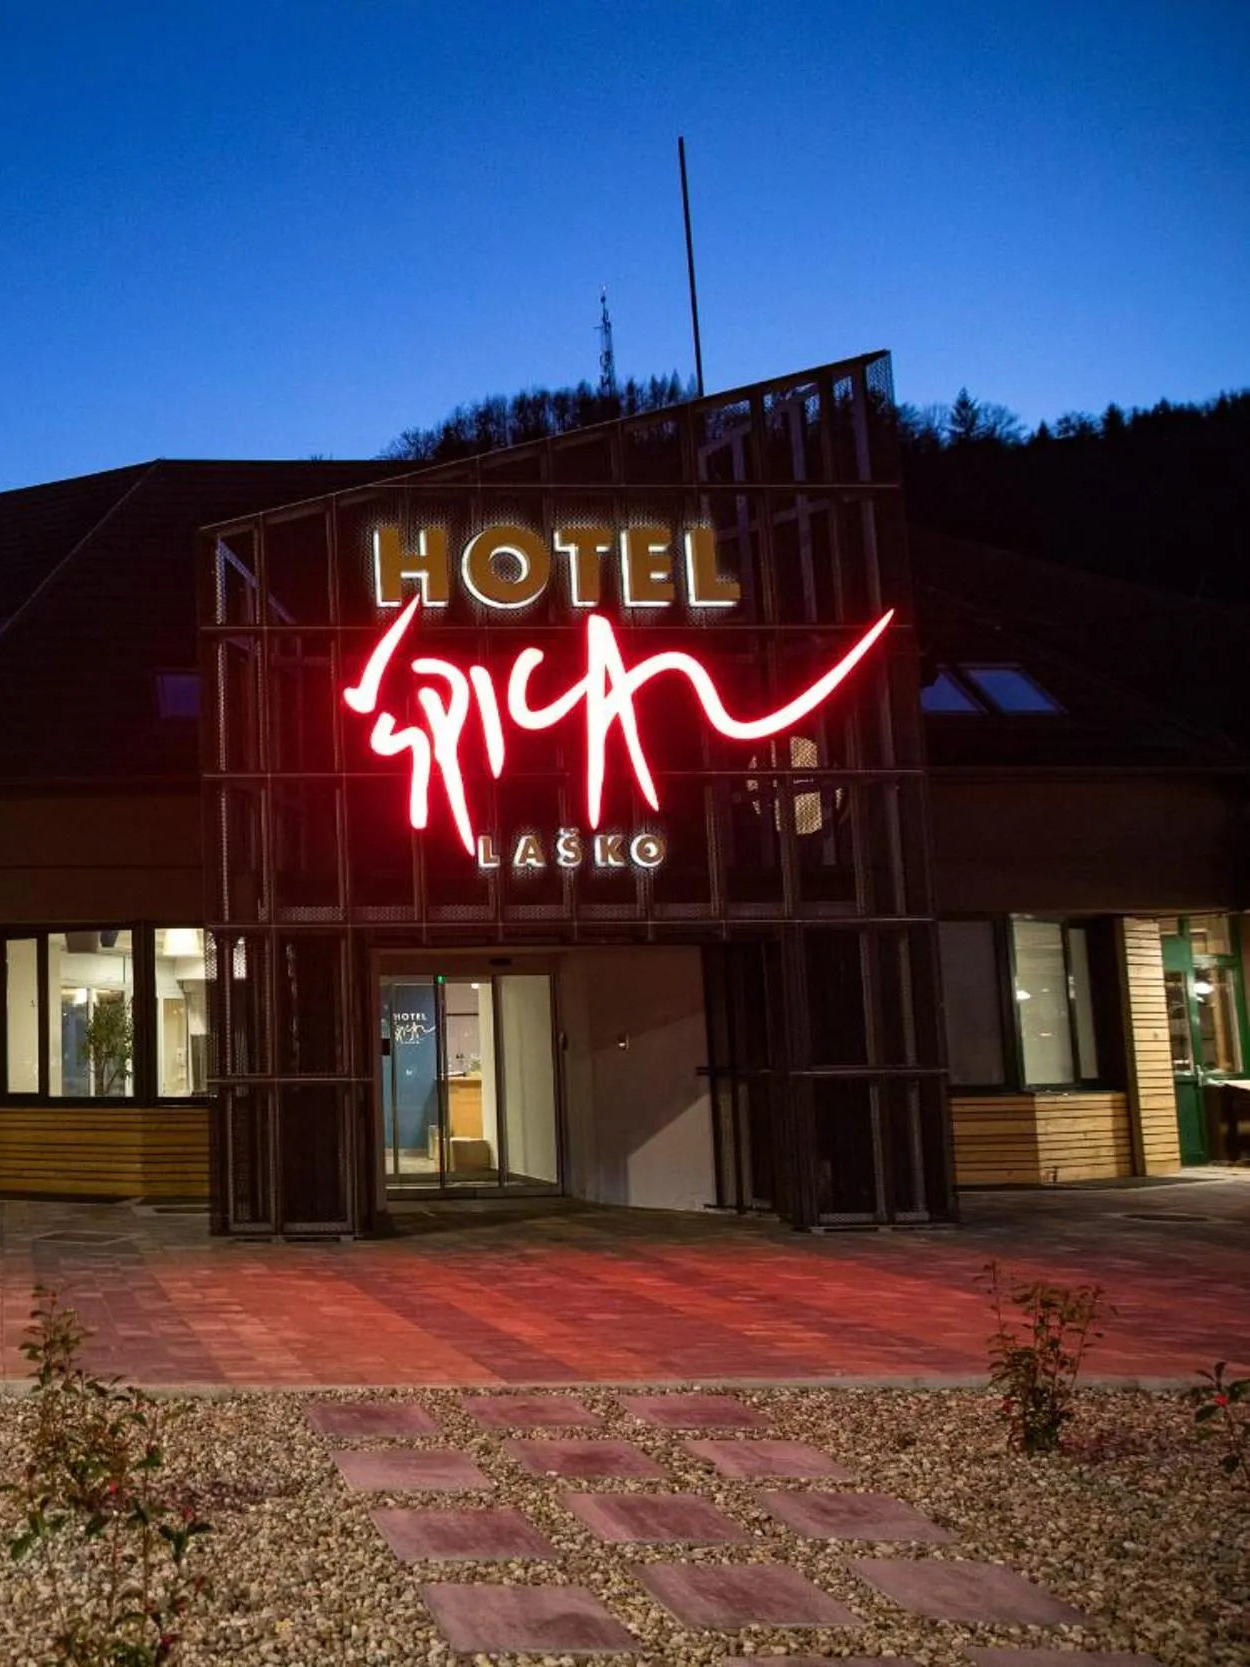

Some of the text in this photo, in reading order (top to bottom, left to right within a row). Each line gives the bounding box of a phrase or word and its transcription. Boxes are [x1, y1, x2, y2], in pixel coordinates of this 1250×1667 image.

[372, 527, 740, 609] HOTEL
[476, 829, 667, 869] LAŠKO
[393, 1012, 427, 1021] HOTEL
